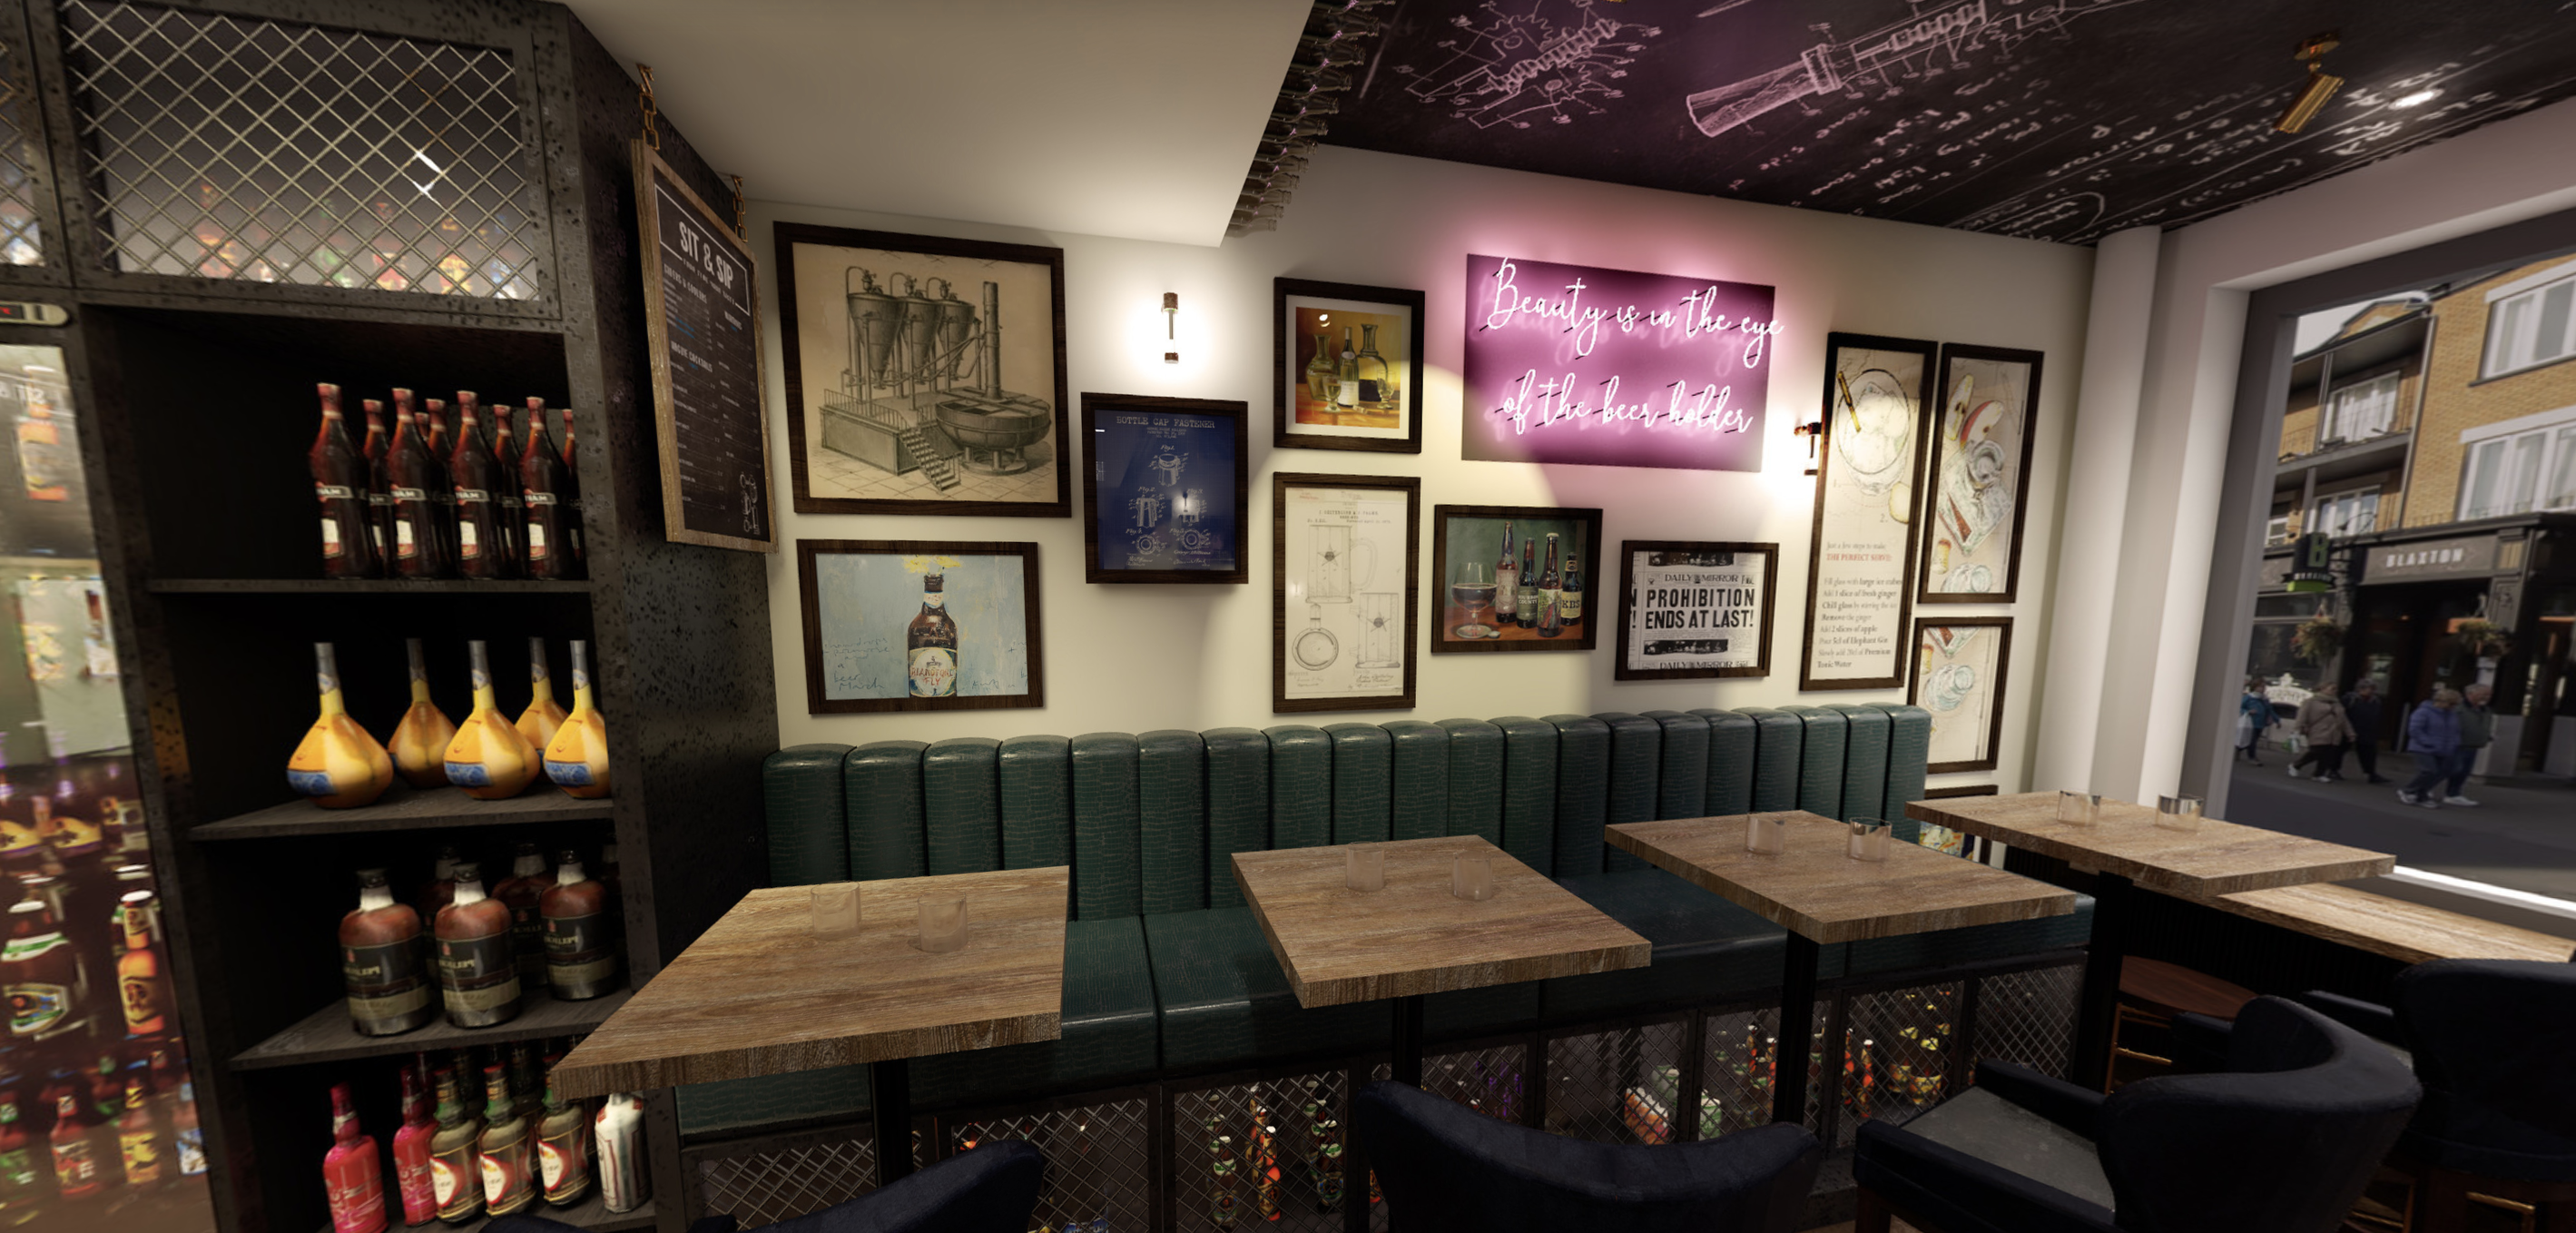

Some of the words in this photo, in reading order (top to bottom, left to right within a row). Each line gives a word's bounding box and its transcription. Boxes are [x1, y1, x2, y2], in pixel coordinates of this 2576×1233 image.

[679, 221, 699, 262] SIT
[703, 242, 714, 276] &
[716, 254, 733, 290] SIP
[1488, 257, 1607, 356] Beauty
[1617, 304, 1640, 333] is
[1650, 308, 1677, 329] in
[1681, 286, 1731, 340] the
[1740, 316, 1785, 369] eye
[1503, 370, 1538, 435] of
[1539, 373, 1591, 427] the
[1602, 375, 1660, 429] beer
[1668, 380, 1754, 434] holder
[1116, 417, 1149, 425] BOTTLE
[1153, 418, 1169, 426] CAP
[1174, 419, 1215, 429] FASTENER
[2307, 532, 2330, 568] B
[2385, 547, 2464, 567] BLAXTON
[1665, 574, 1692, 582] DAILY
[1859, 577, 1874, 587] large
[1562, 599, 1580, 609] KBS
[1647, 588, 1755, 608] PROHIBITION
[1878, 591, 1896, 599] ginger
[1645, 609, 1685, 630] ENDS
[1688, 609, 1709, 628] AT
[1712, 609, 1754, 628] LAST!
